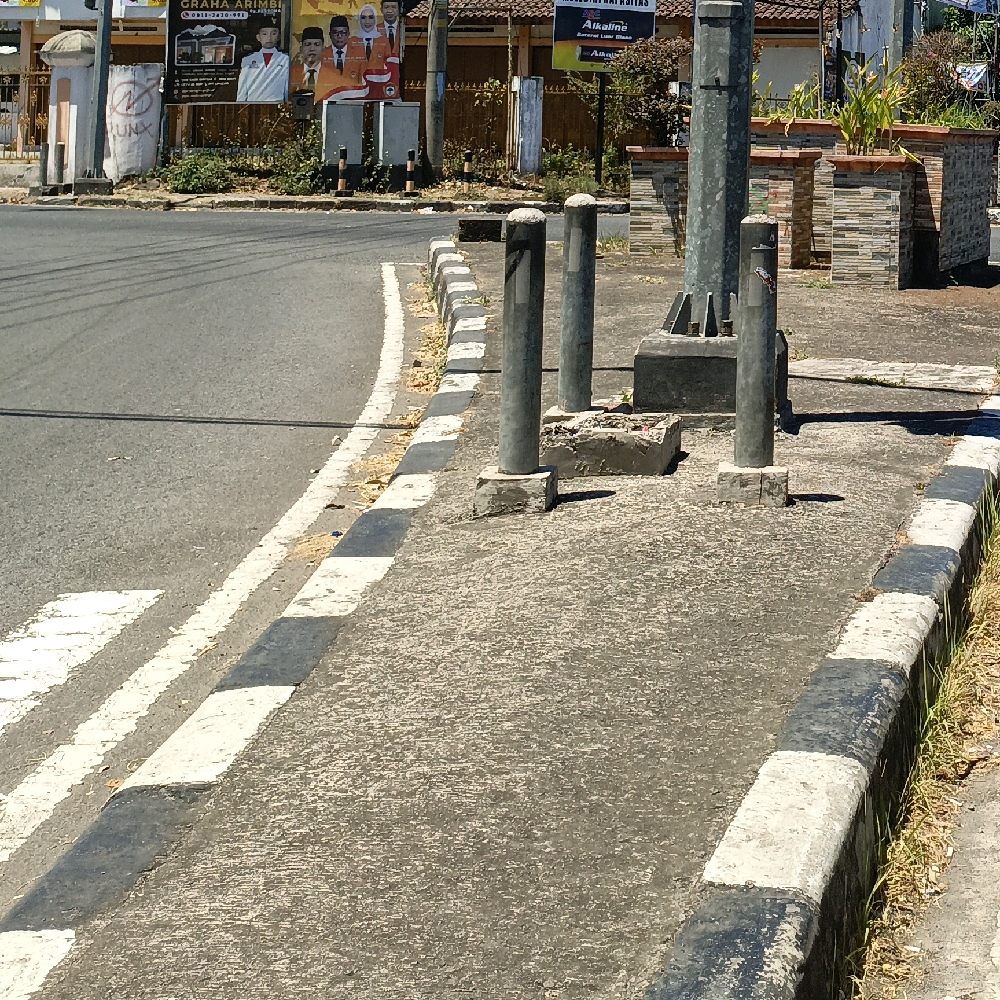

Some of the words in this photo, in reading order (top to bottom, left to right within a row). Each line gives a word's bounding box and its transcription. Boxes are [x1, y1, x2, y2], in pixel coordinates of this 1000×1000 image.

[180, 0, 230, 9] GRAHA
[234, 0, 282, 9] ARIMBI
[581, 19, 628, 32] Alkaline
